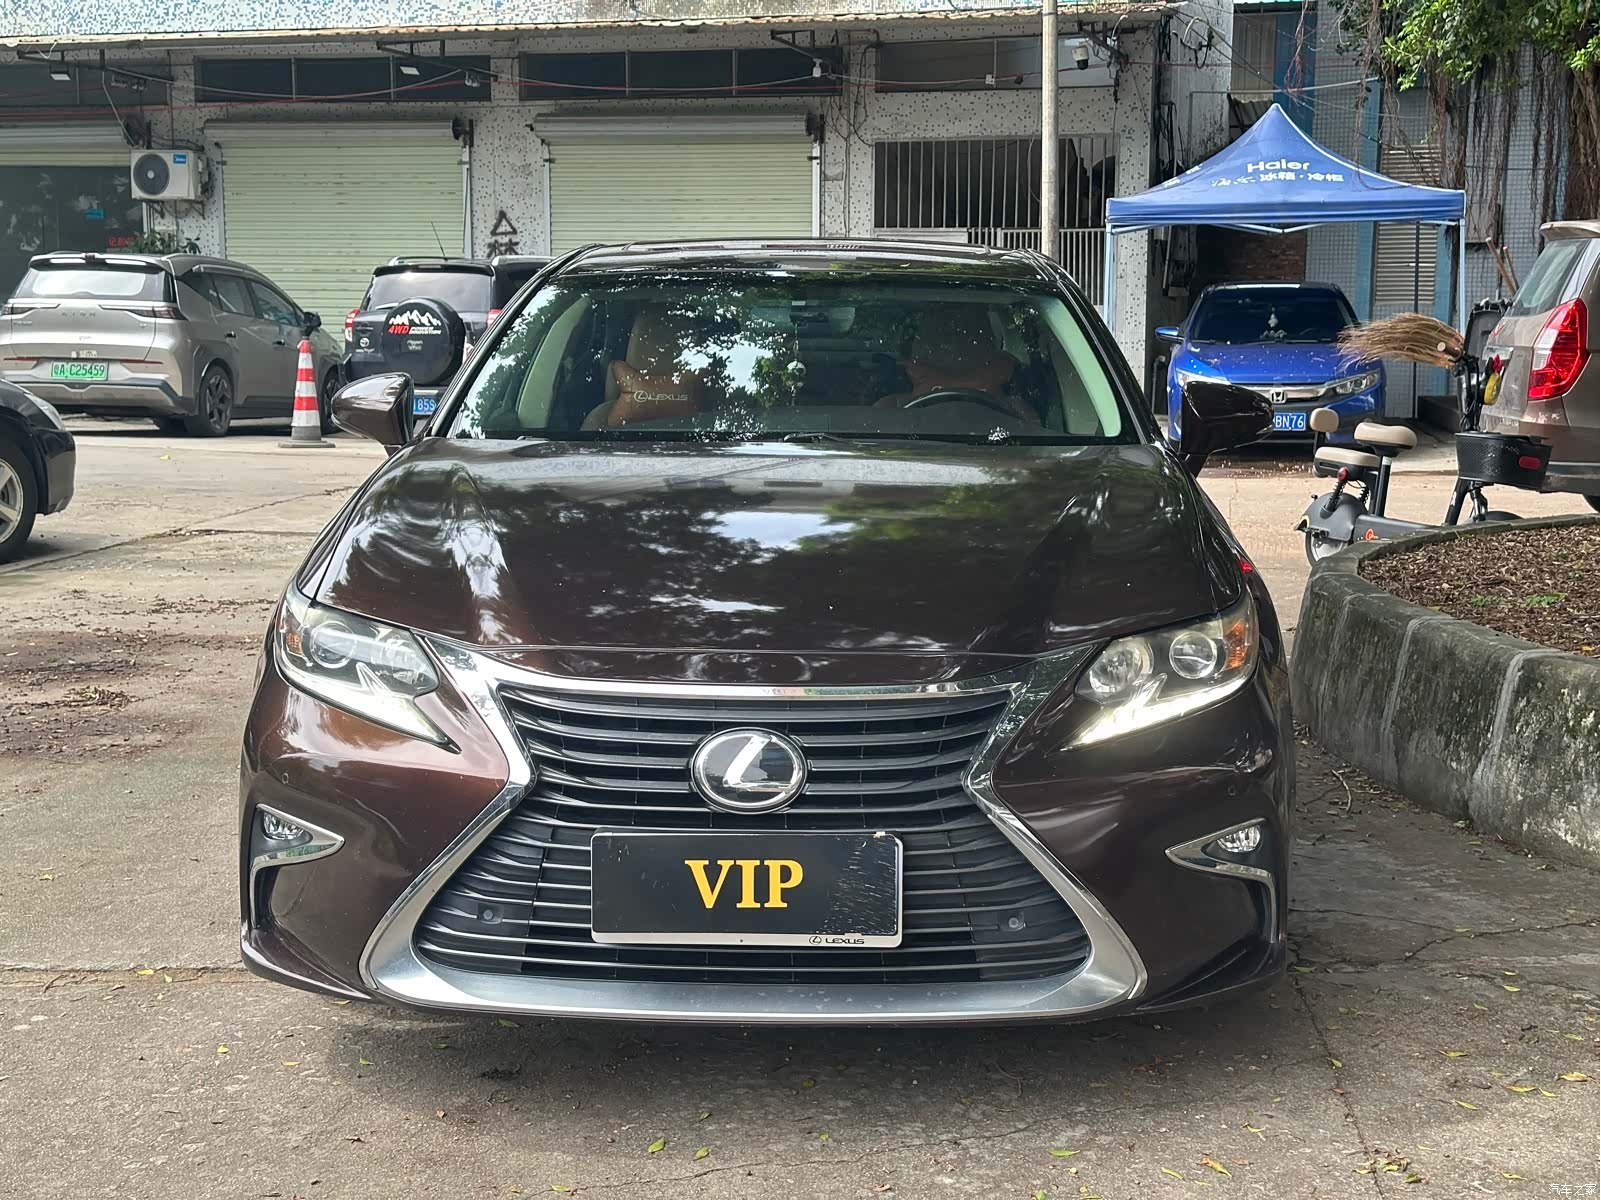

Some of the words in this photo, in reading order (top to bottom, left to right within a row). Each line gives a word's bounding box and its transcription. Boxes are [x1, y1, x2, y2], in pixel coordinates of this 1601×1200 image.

[1247, 159, 1310, 173] Haier
[388, 325, 410, 334] 4WD
[1275, 415, 1304, 428] BN76
[684, 859, 804, 909] VIP
[825, 936, 865, 945] LEXUS
